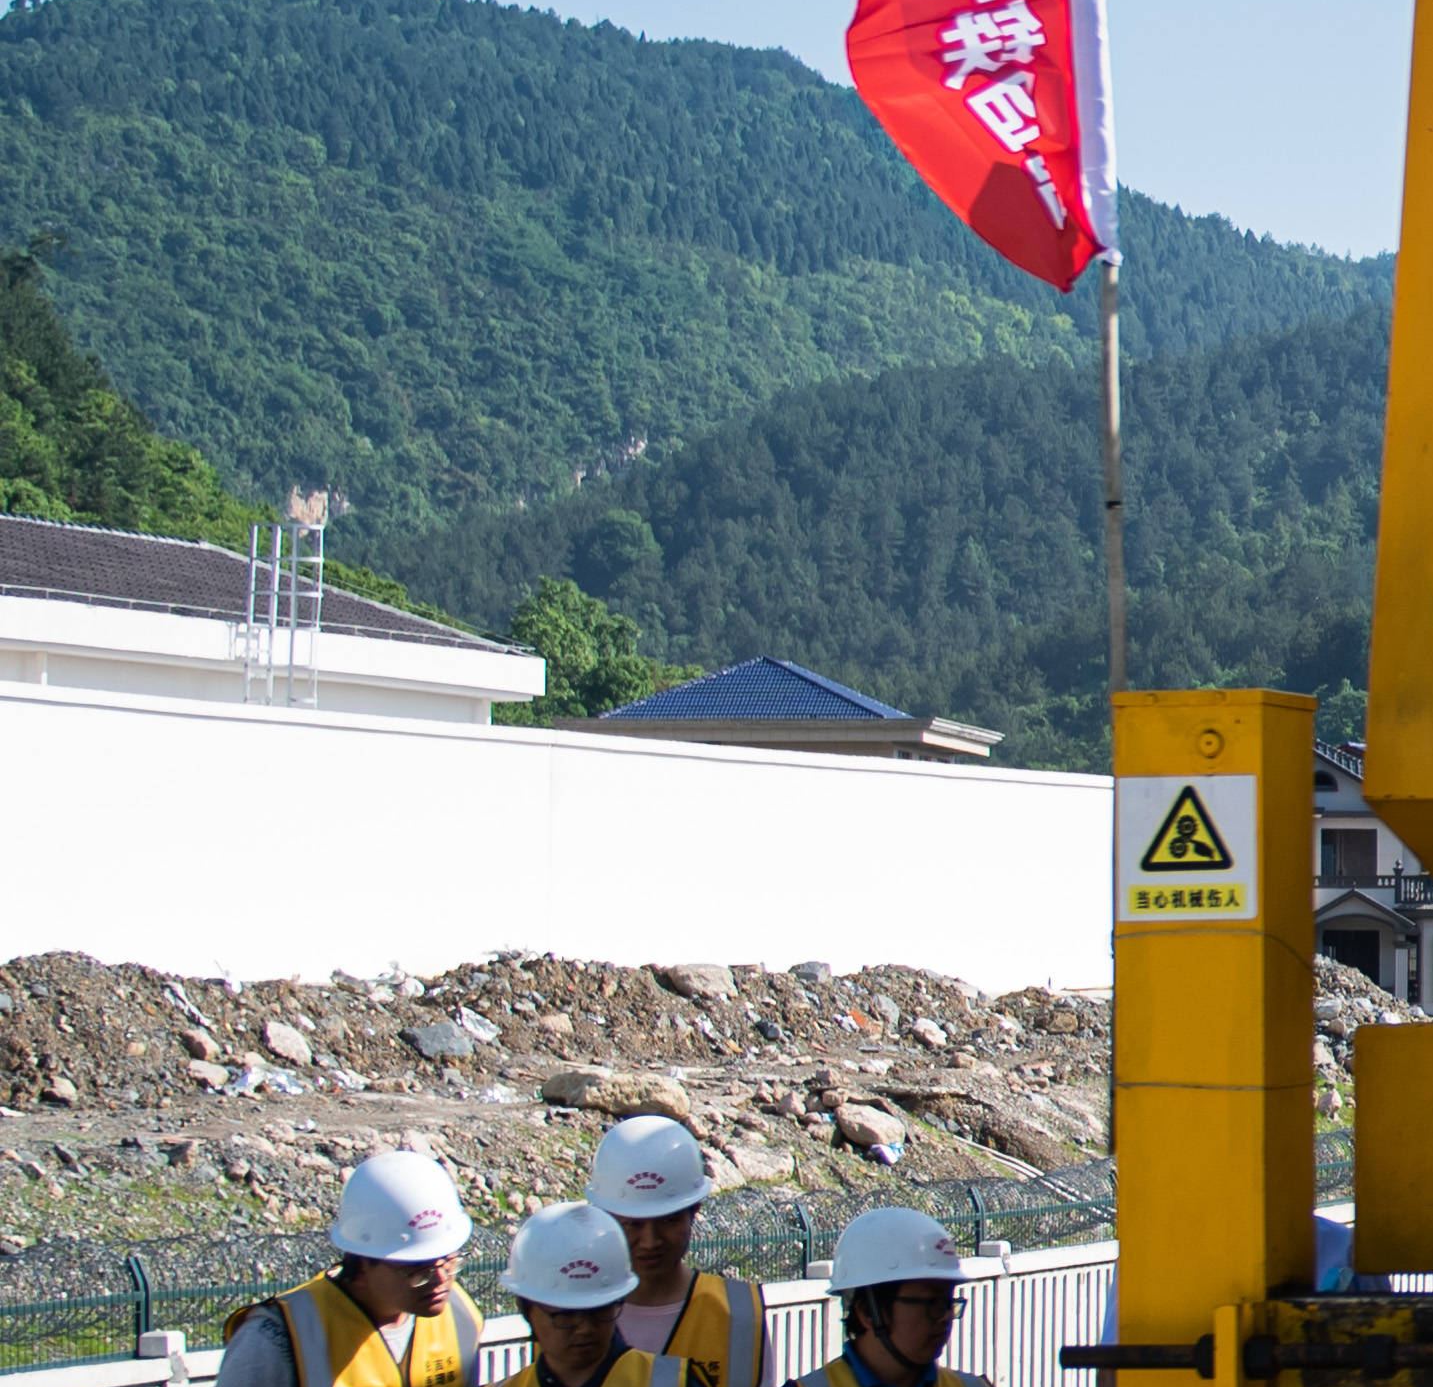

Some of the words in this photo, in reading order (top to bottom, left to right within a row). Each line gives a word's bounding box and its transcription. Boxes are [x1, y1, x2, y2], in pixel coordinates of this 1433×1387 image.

[1136, 888, 1240, 909] 当心机械伤人
